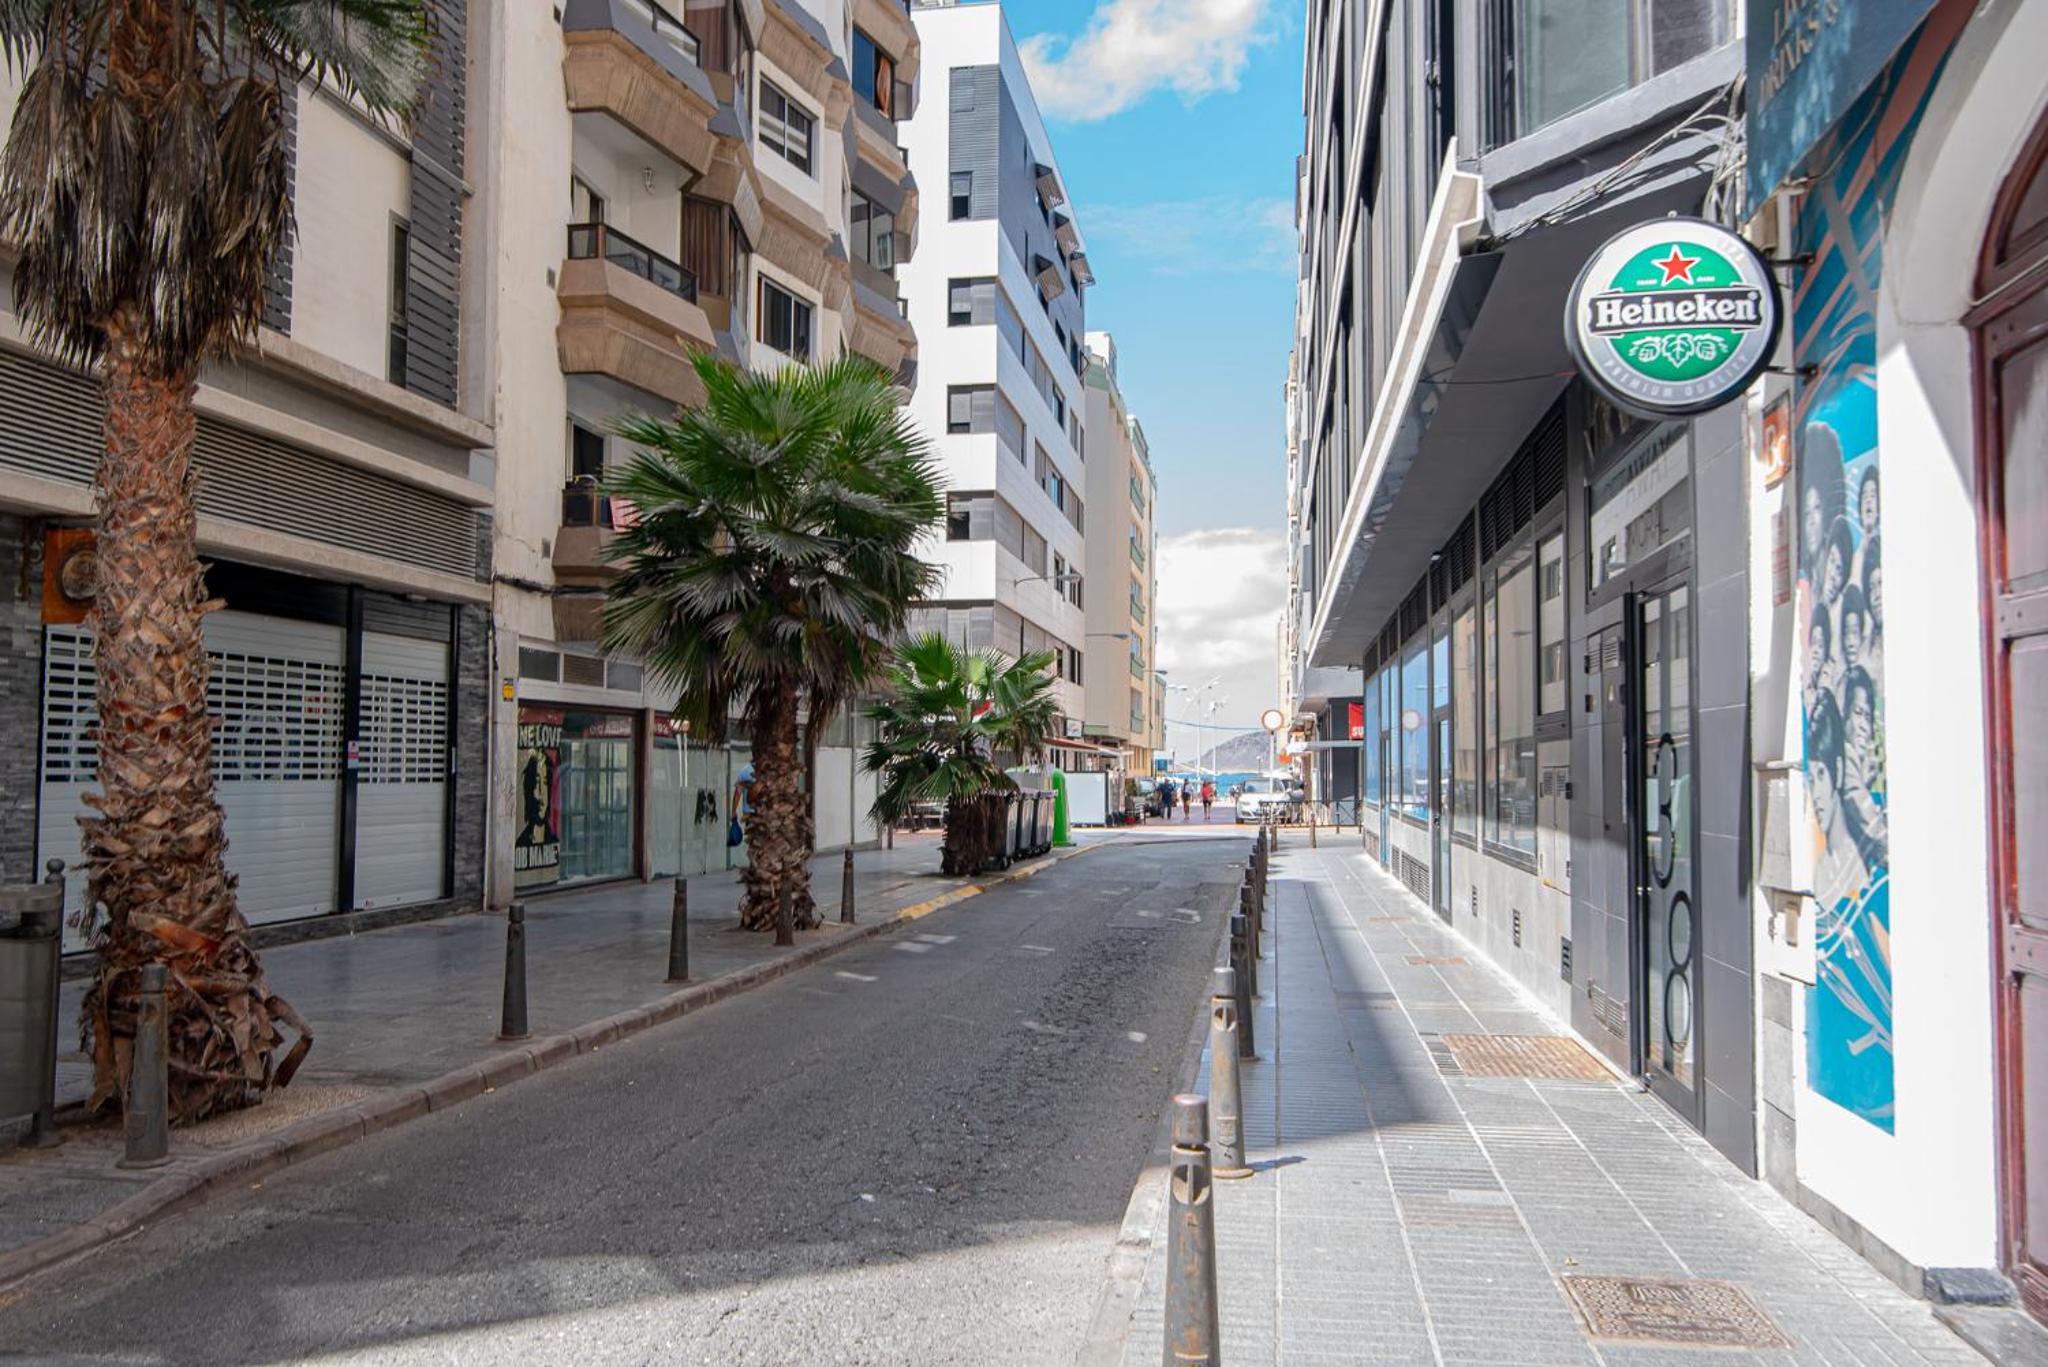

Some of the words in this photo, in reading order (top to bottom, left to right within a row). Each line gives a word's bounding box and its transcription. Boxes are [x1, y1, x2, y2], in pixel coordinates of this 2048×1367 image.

[1596, 294, 1757, 328] Heineken
[519, 724, 535, 747] NE
[1352, 726, 1364, 738] SU
[515, 846, 528, 870] OB
